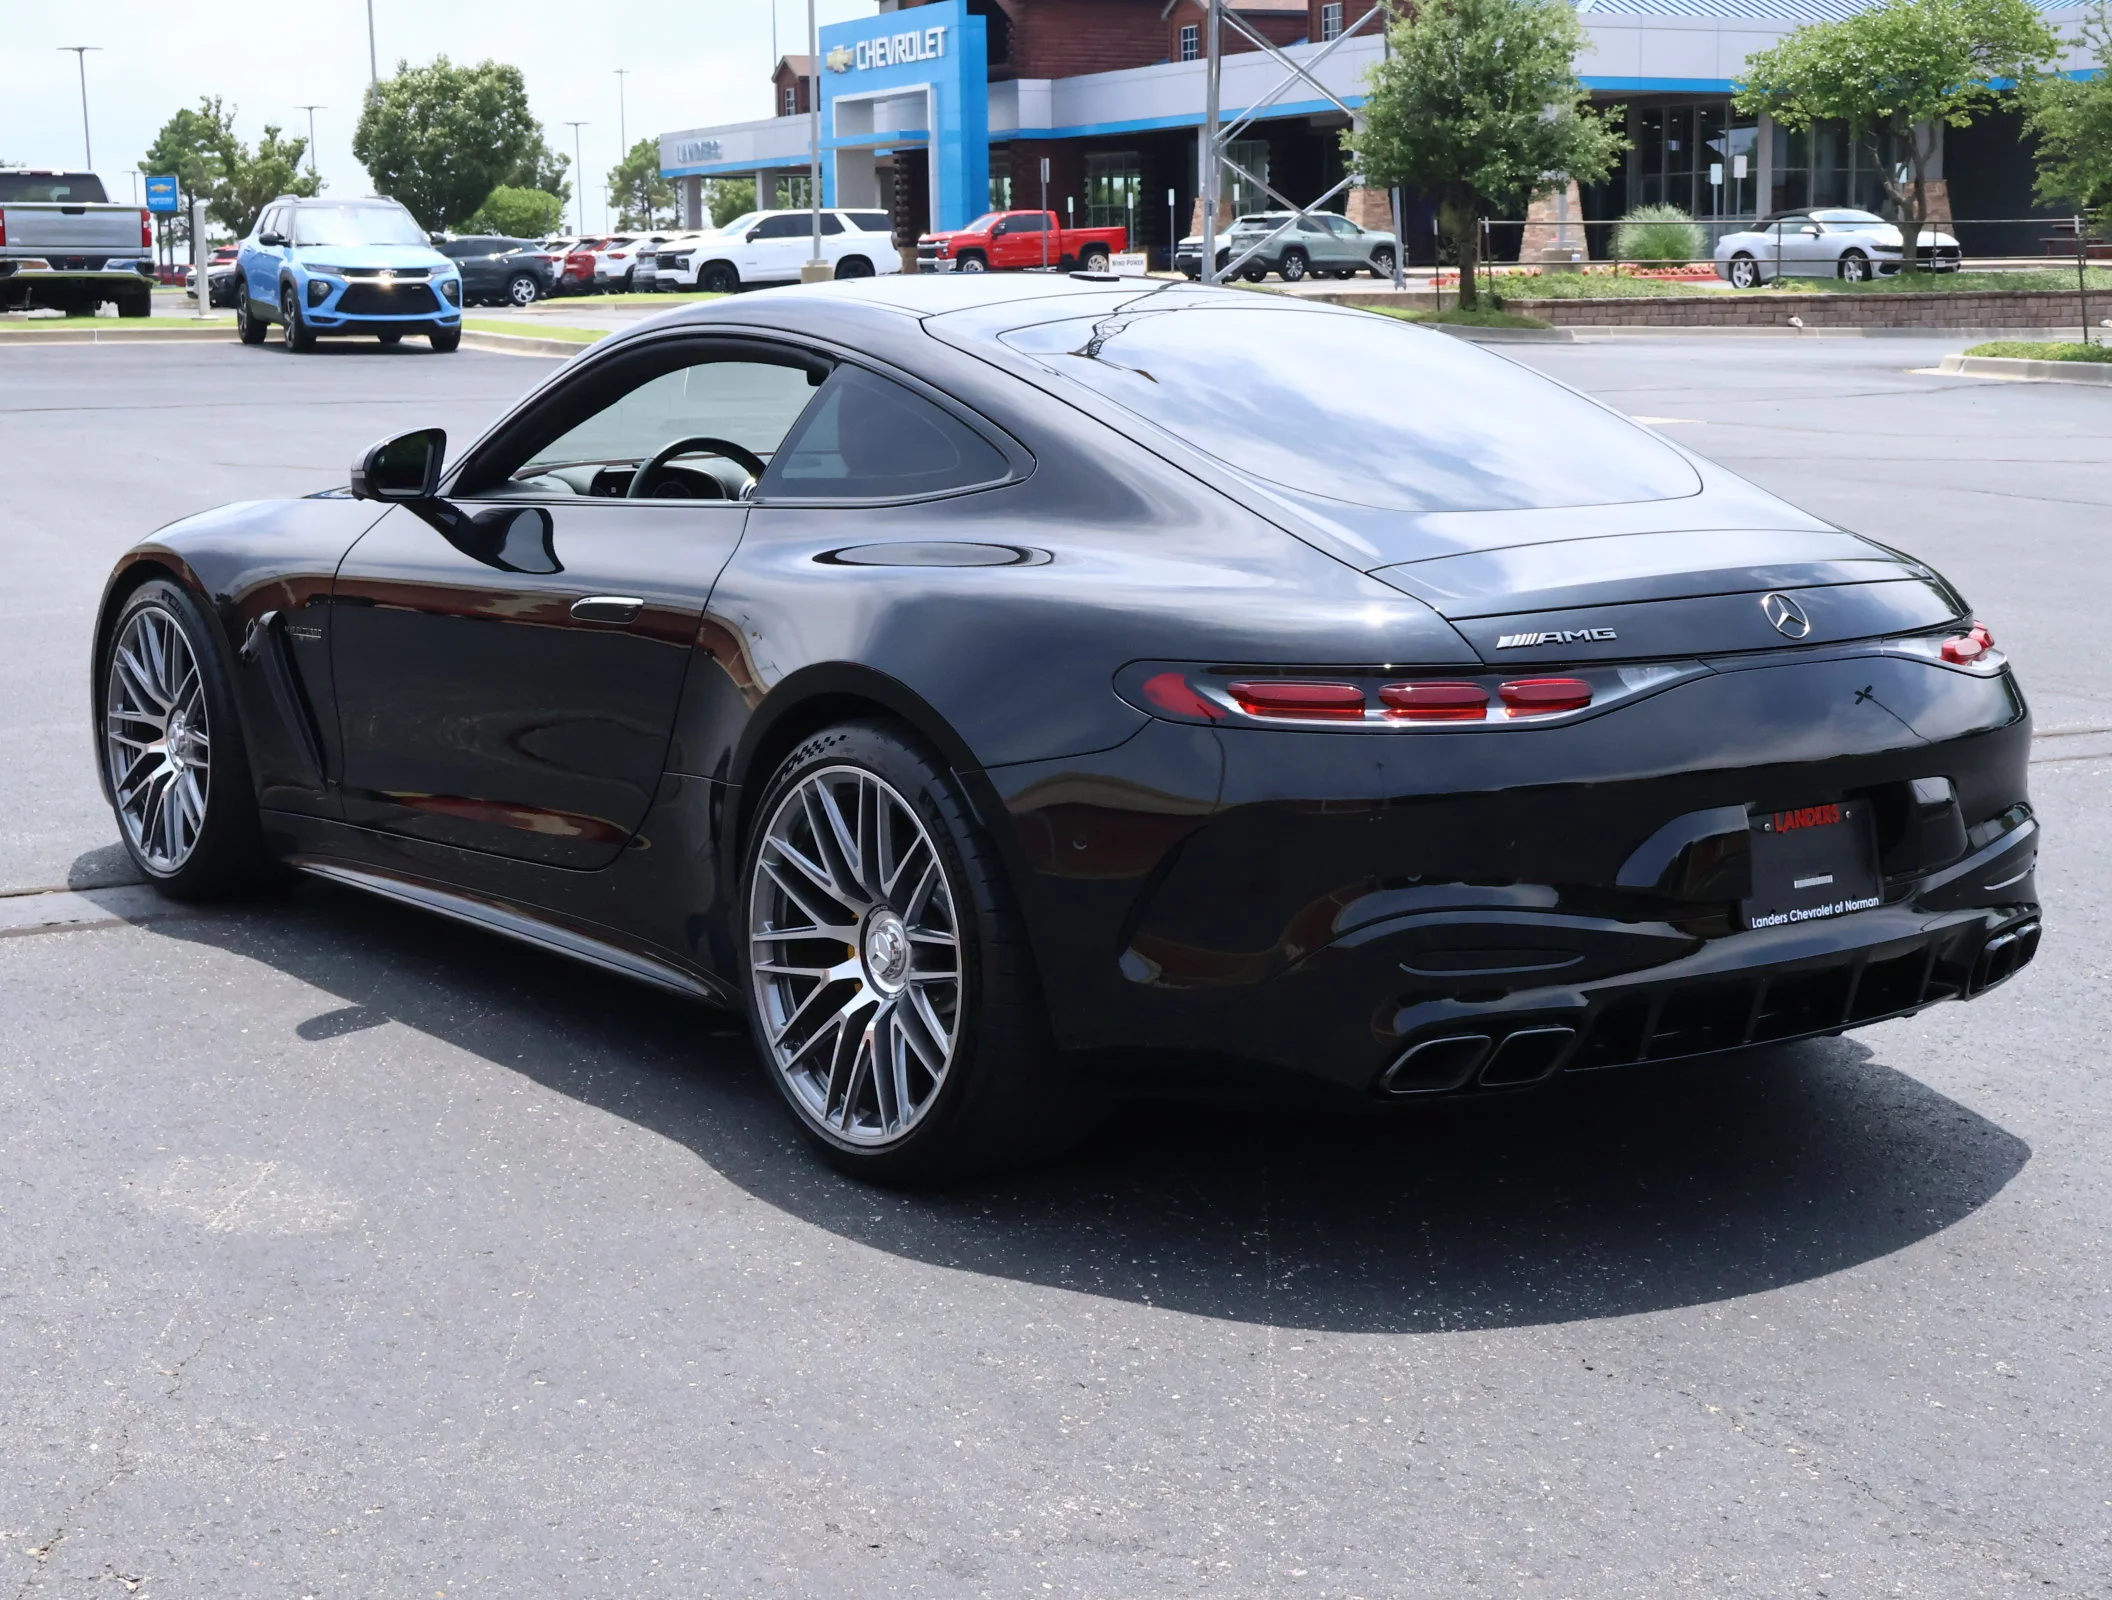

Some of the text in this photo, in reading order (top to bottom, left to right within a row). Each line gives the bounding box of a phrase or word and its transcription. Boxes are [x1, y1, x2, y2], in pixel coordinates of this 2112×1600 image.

[856, 25, 947, 71] CHEVROLET
[1535, 627, 1617, 647] AMG
[1773, 804, 1838, 833] LANDERS
[1751, 897, 1880, 929] Landers Chevrolet of Norman
